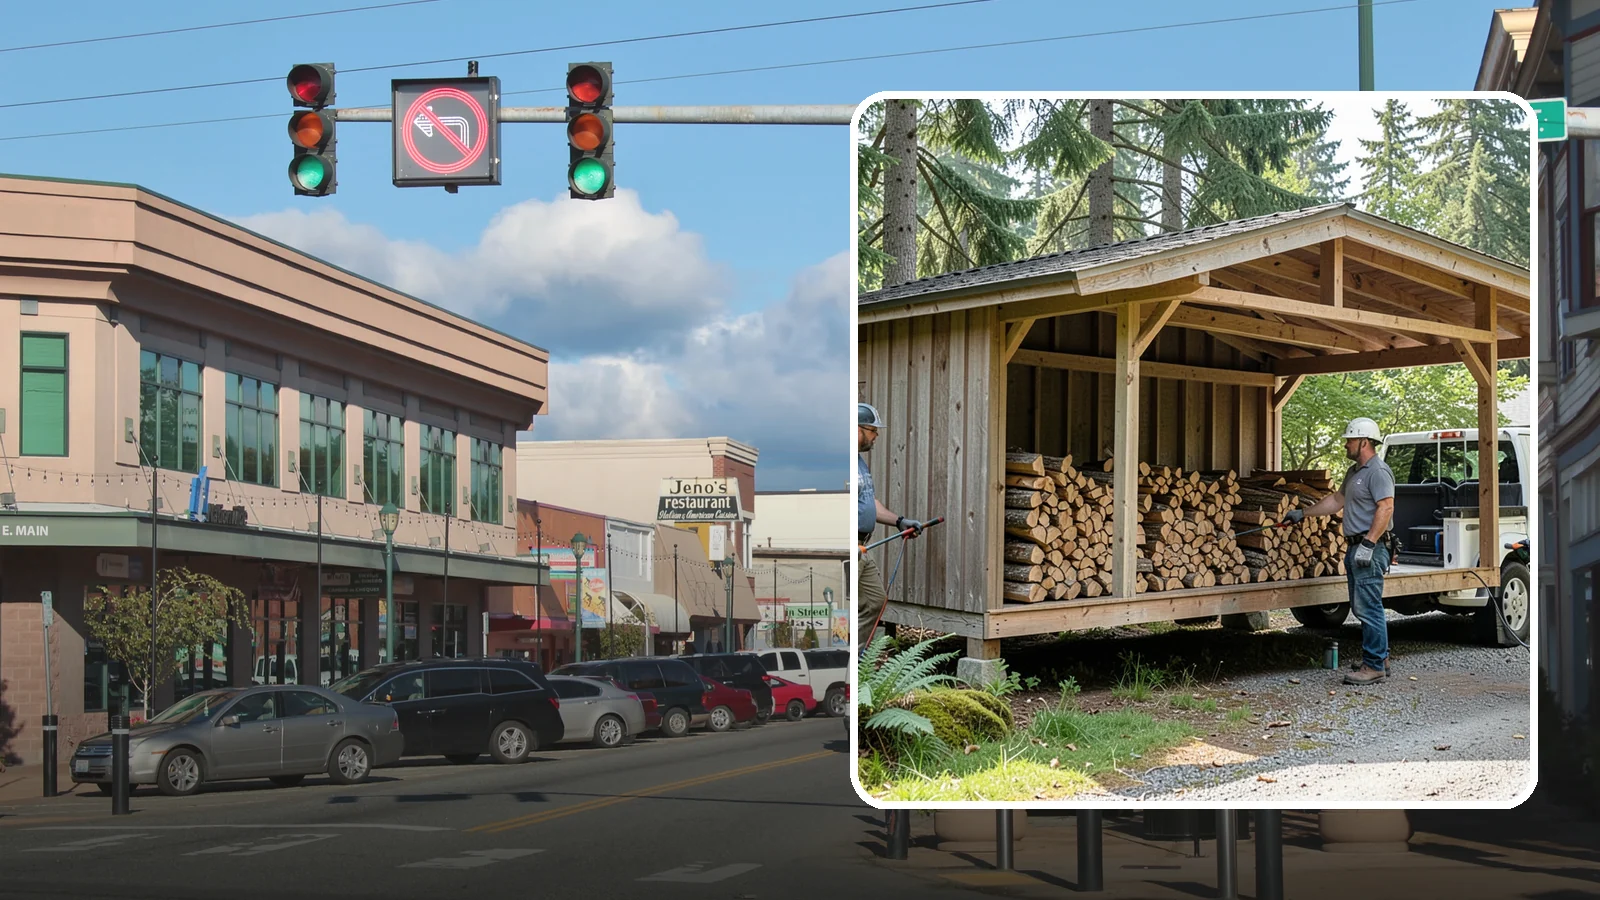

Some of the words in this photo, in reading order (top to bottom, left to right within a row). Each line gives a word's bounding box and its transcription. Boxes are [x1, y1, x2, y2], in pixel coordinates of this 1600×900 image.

[669, 480, 727, 494] Jeno's
[665, 496, 731, 509] restaurant
[658, 509, 681, 519] Italian
[686, 509, 714, 519] American
[715, 509, 738, 519] Cuisine
[2, 525, 13, 536] E.
[15, 525, 49, 536] MAIN
[797, 607, 828, 617] Street
